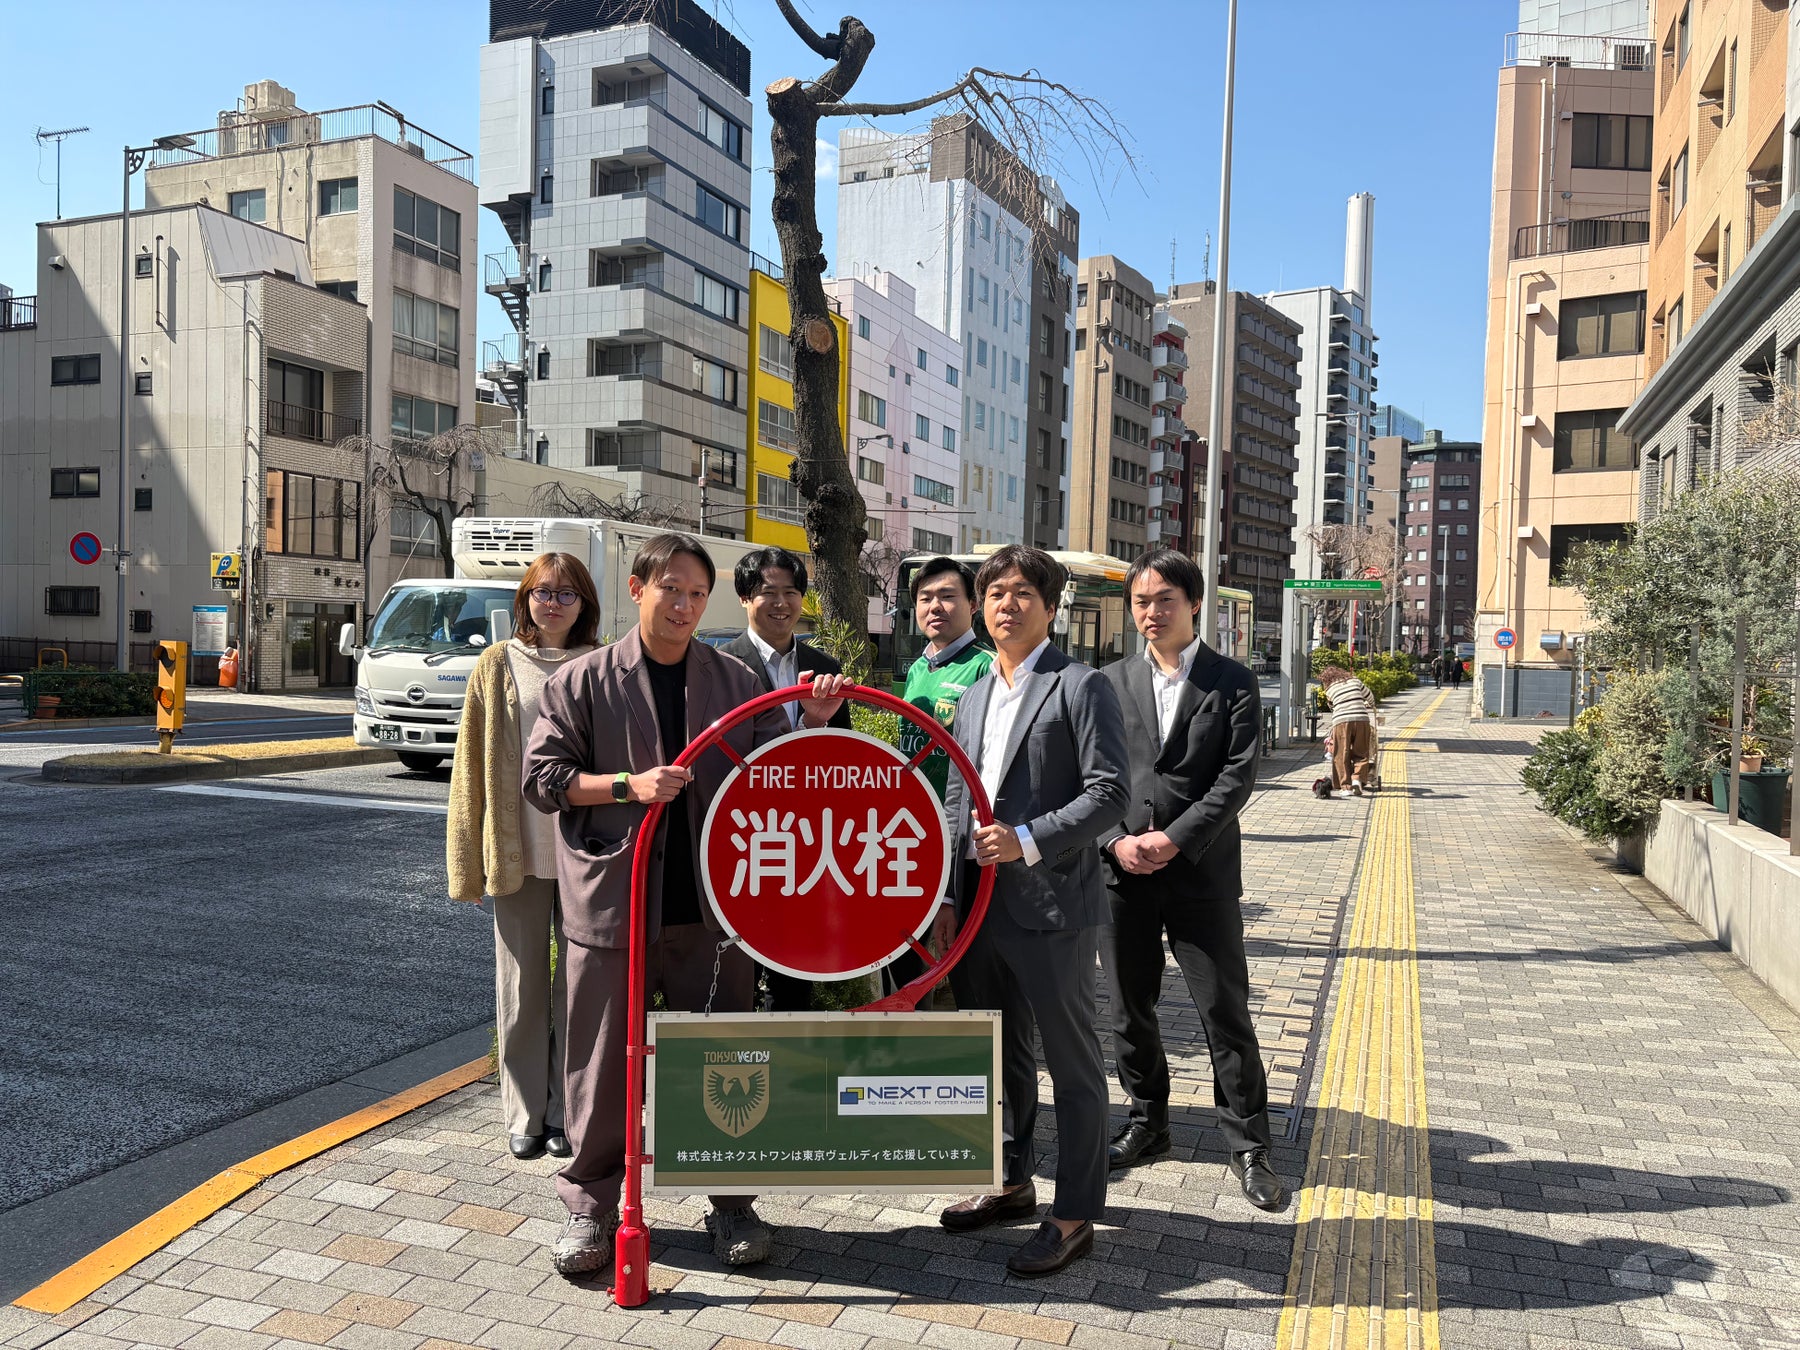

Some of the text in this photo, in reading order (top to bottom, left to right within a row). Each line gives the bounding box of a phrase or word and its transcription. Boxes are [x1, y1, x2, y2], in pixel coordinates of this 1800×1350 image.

[749, 765, 904, 789] FIRE HYDRANT
[729, 807, 927, 897] 消火栓
[867, 1086, 985, 1099] NEXT ONE
[676, 1149, 977, 1162] 株式会社ネクストワンは東京ヴェルディを応援しています。
